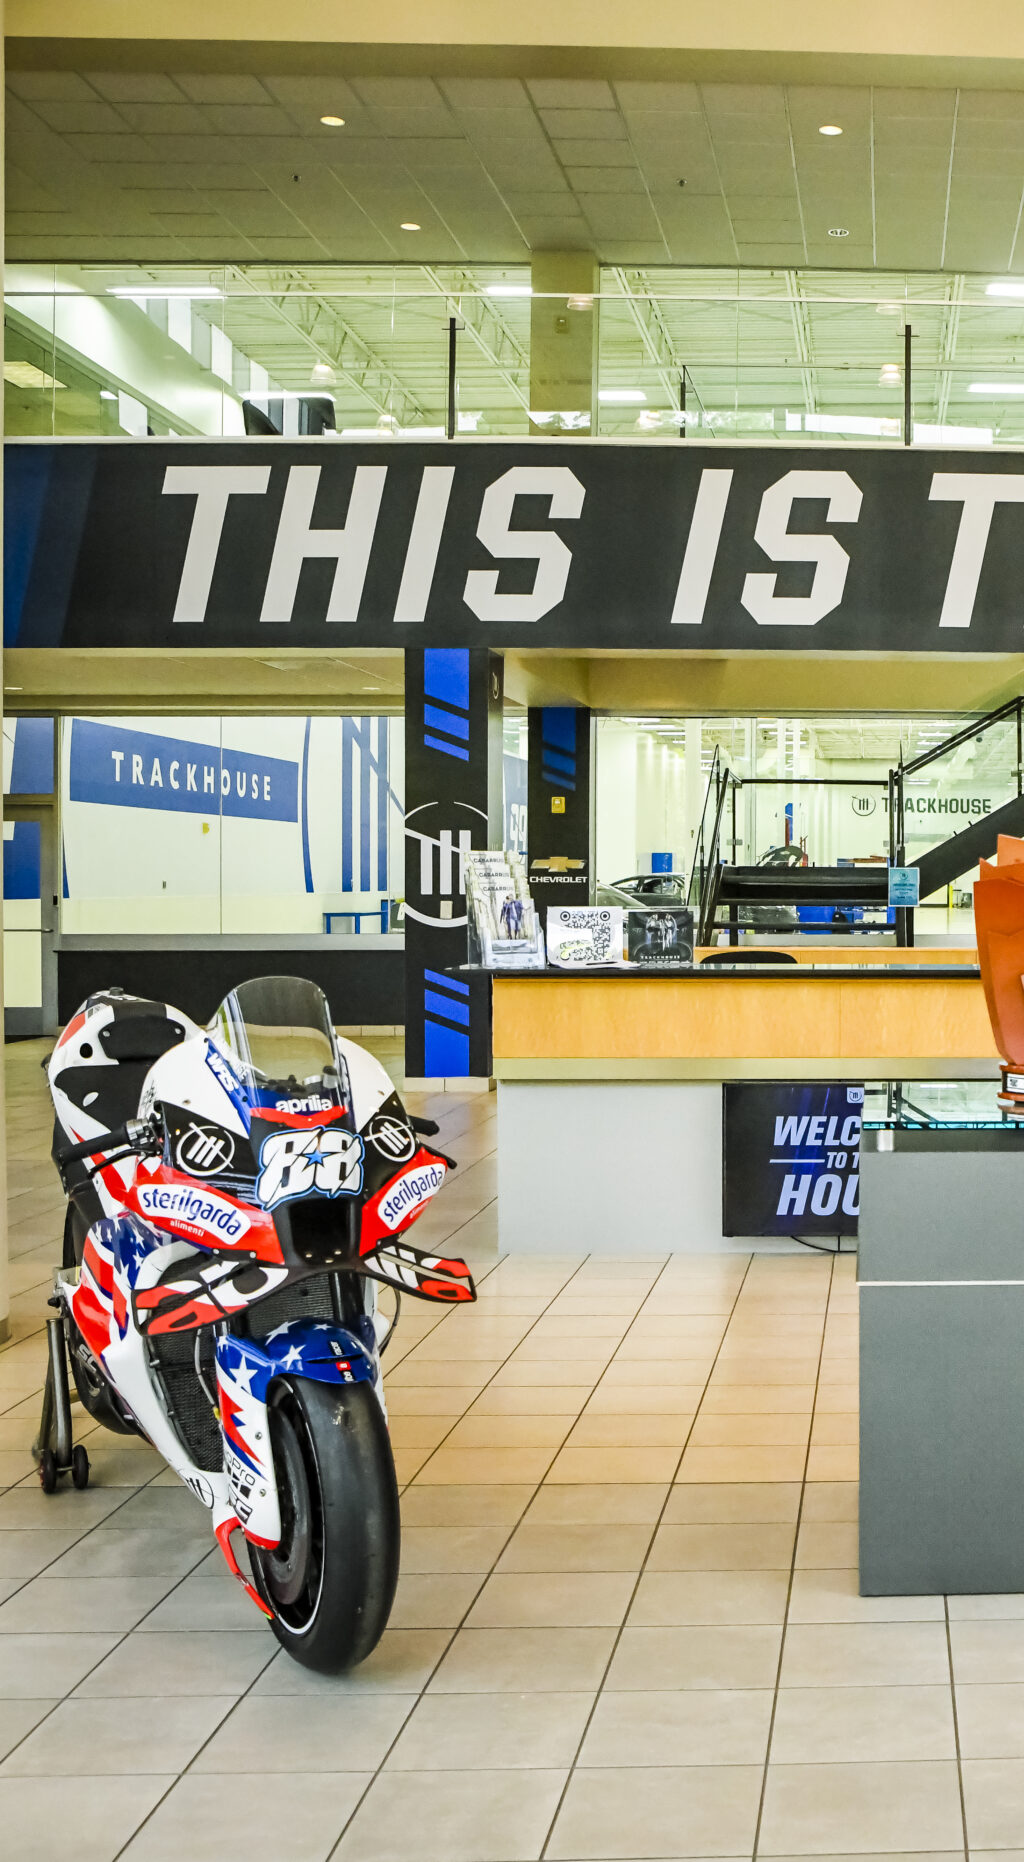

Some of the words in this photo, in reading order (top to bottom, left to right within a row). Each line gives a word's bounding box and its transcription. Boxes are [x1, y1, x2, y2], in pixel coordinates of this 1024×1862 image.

[161, 465, 586, 622] THIS
[671, 469, 863, 626] IS
[112, 751, 271, 801] TRACKHOUSE
[529, 876, 588, 884] CHEVROLET
[275, 1094, 333, 1115] aprilia
[773, 1115, 861, 1147] WELC
[257, 1127, 364, 1211] 88
[826, 1151, 848, 1169] TO
[143, 1187, 242, 1236] sterilgarda
[384, 1166, 443, 1222] sterilgarda
[776, 1174, 860, 1216] HOU
[170, 1219, 205, 1237] alimenti
